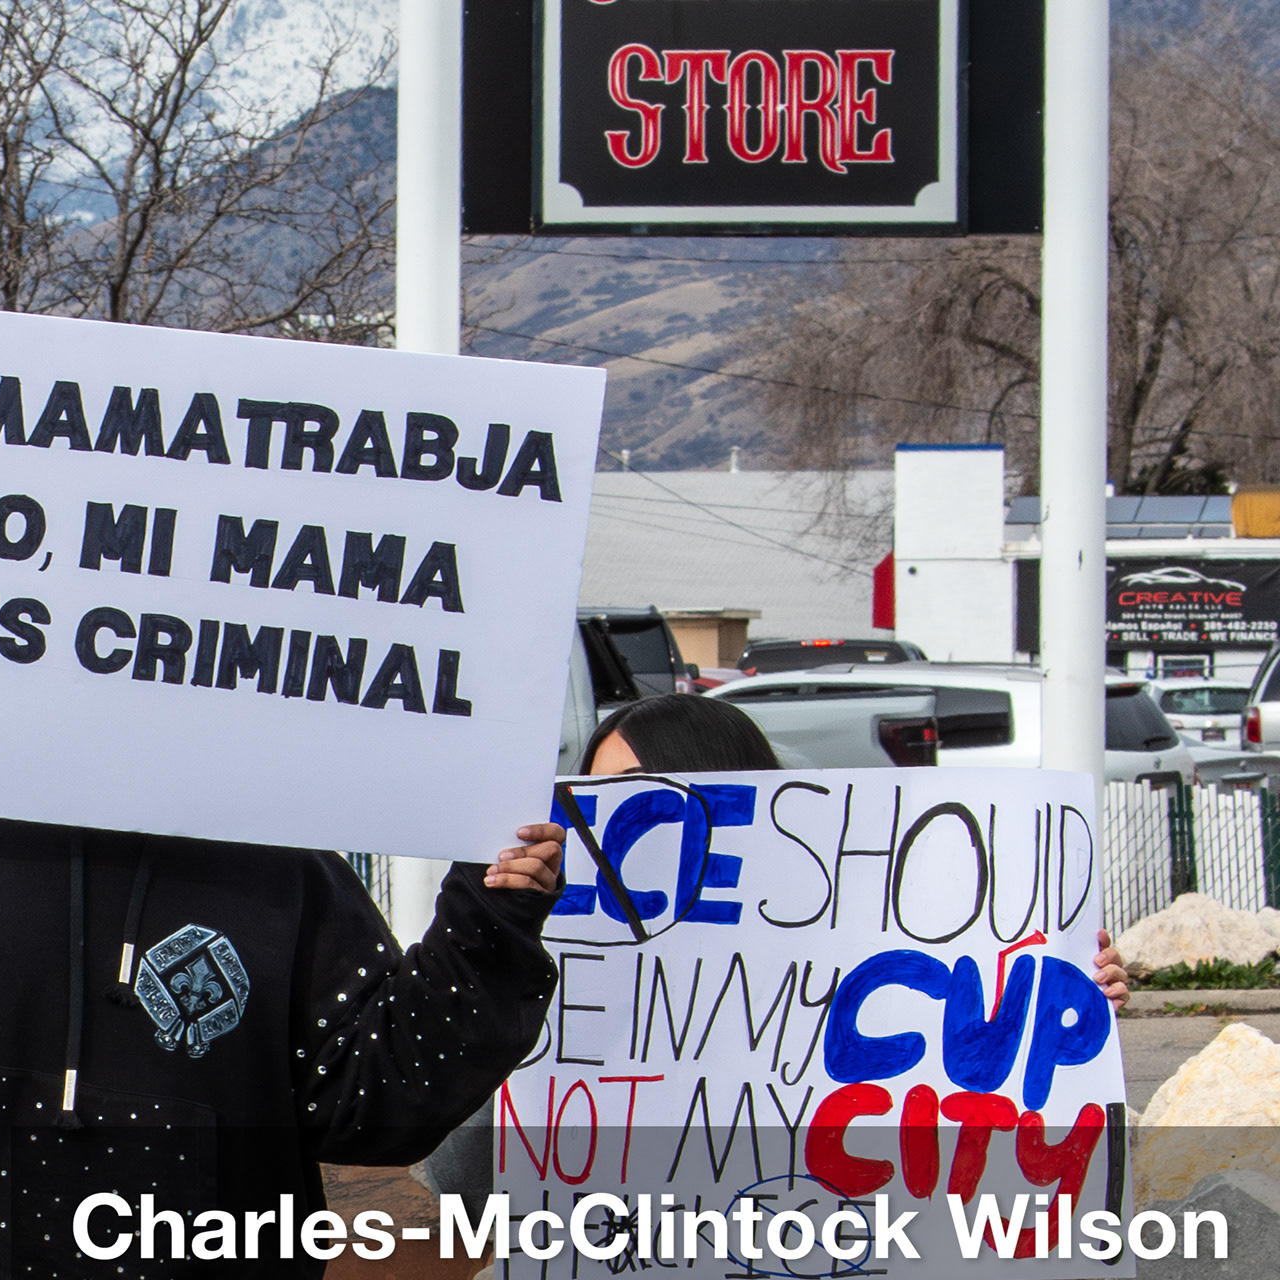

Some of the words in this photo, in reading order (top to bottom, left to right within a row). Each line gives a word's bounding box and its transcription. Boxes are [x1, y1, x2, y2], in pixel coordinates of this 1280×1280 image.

[605, 42, 895, 174] STORE
[79, 501, 177, 577] MI
[209, 514, 464, 613] MAMA
[1118, 592, 1243, 606] CREATIVE
[74, 606, 472, 717] CRIMINAL
[1122, 632, 1149, 641] SELL
[1162, 632, 1198, 641] TRADE
[1209, 632, 1227, 641] WE
[1230, 632, 1278, 641] FINANCE
[547, 782, 757, 925] ICE
[822, 946, 1112, 1110] CUP
[500, 1073, 665, 1186] NOT
[666, 1076, 814, 1192] MY
